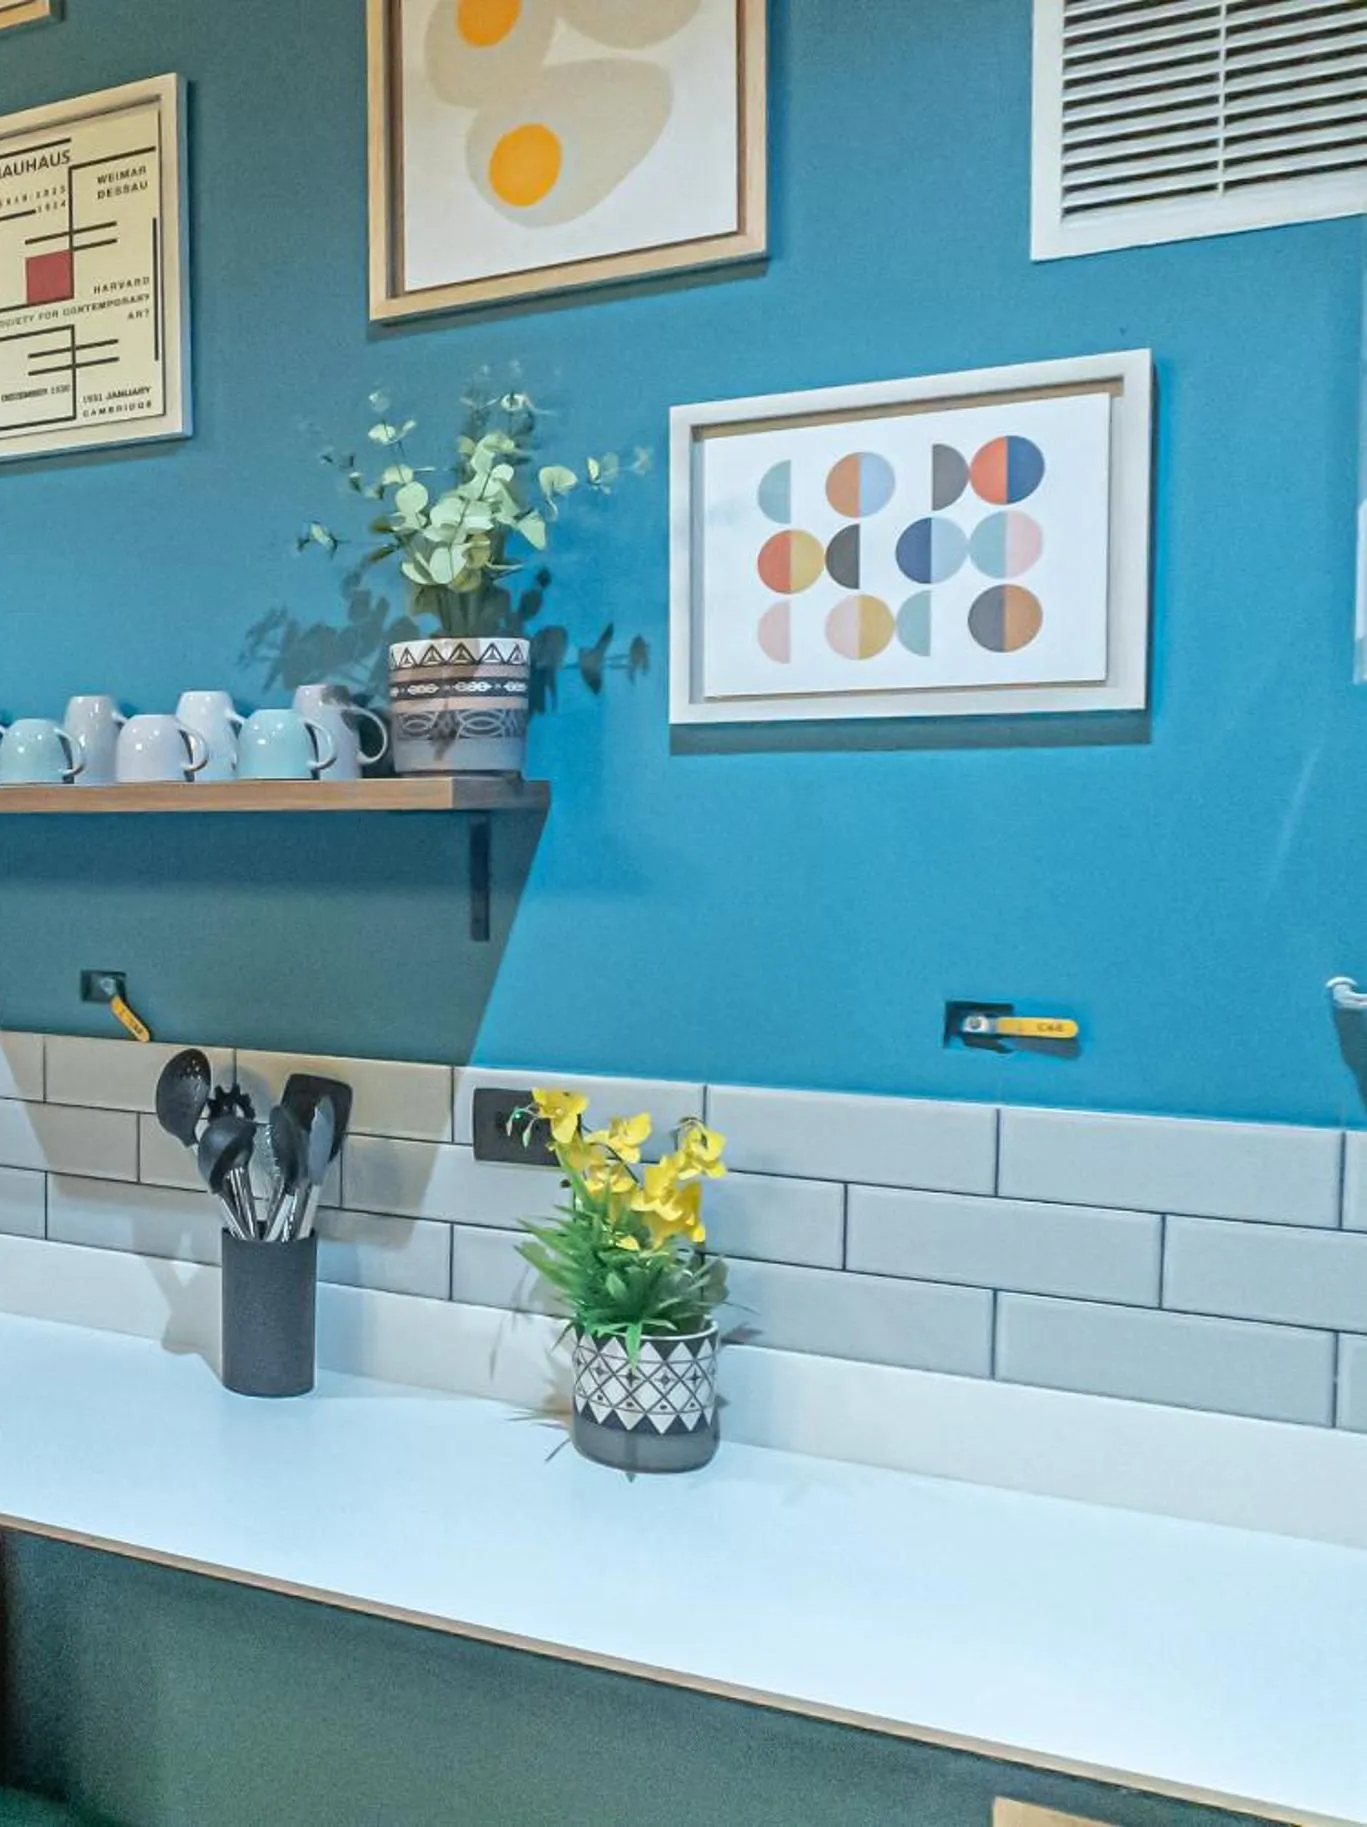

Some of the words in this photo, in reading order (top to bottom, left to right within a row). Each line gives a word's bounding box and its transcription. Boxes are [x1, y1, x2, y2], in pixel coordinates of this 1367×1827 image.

[97, 165, 146, 184] WEIMAR
[97, 180, 148, 200] DESSAU
[93, 276, 150, 294] HARVARD
[38, 309, 59, 320] FOR
[83, 400, 152, 417] CAMBRIDGE
